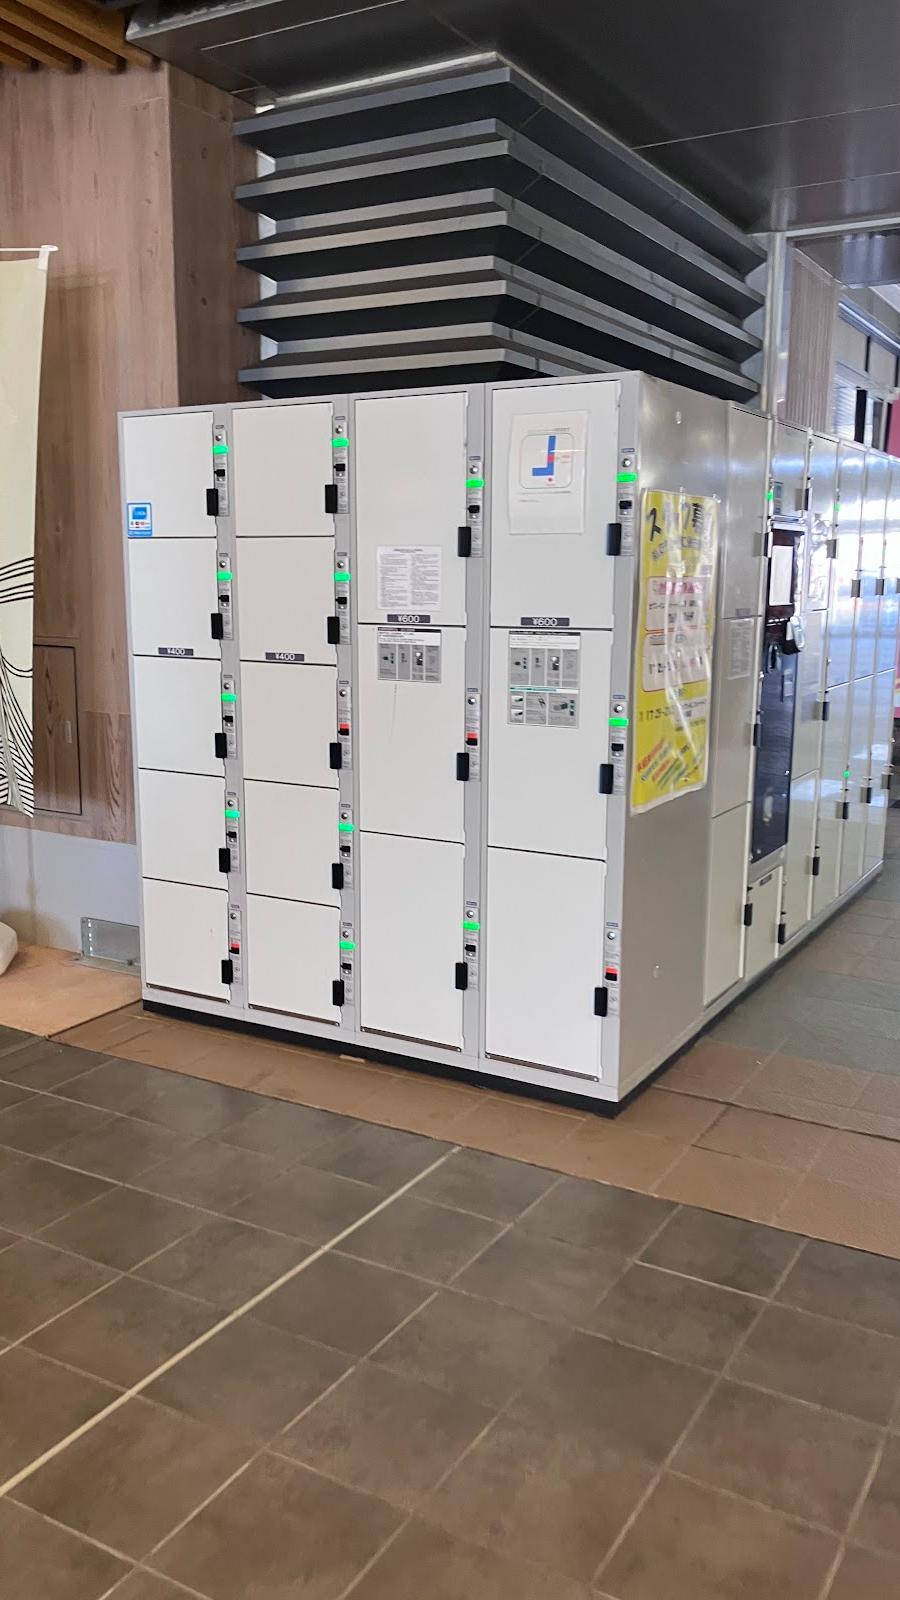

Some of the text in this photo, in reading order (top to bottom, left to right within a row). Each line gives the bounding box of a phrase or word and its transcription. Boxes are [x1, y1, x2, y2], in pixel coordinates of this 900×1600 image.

[397, 615, 420, 623] ¥600
[532, 617, 558, 626] ¥600
[275, 652, 295, 661] ¥400
